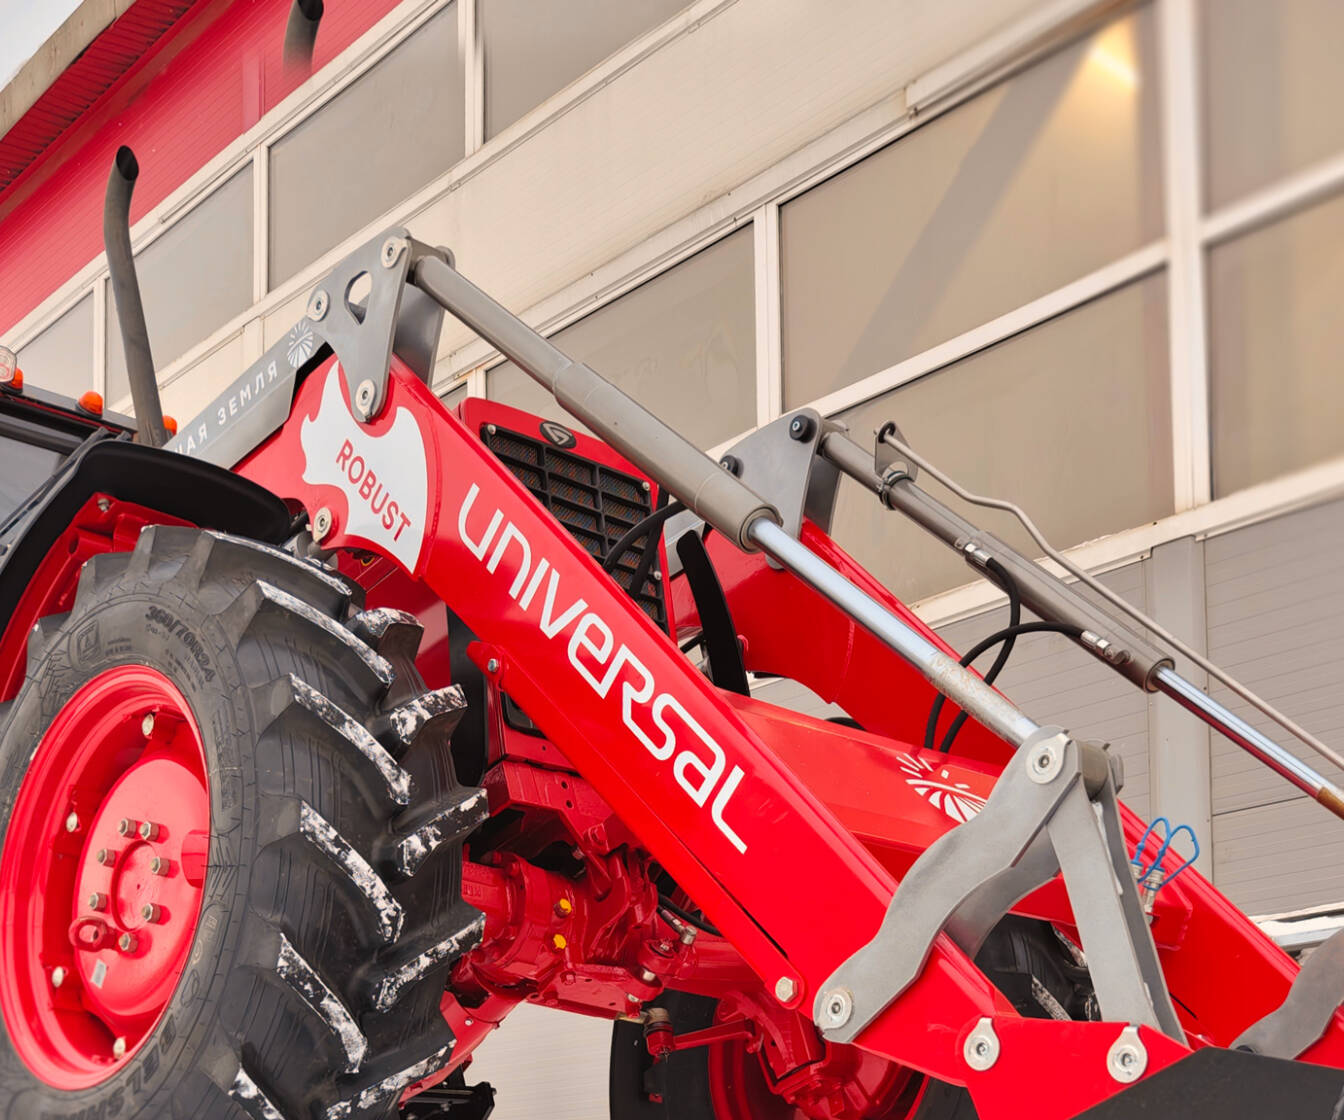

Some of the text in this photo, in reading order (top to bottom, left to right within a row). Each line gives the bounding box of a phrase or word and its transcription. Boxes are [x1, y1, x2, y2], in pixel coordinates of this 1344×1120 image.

[217, 358, 279, 424] ЗЕМЛЯ
[336, 438, 411, 543] ROBUST
[144, 605, 216, 683] 360/70R24
[457, 482, 748, 855] UNIVERSAL
